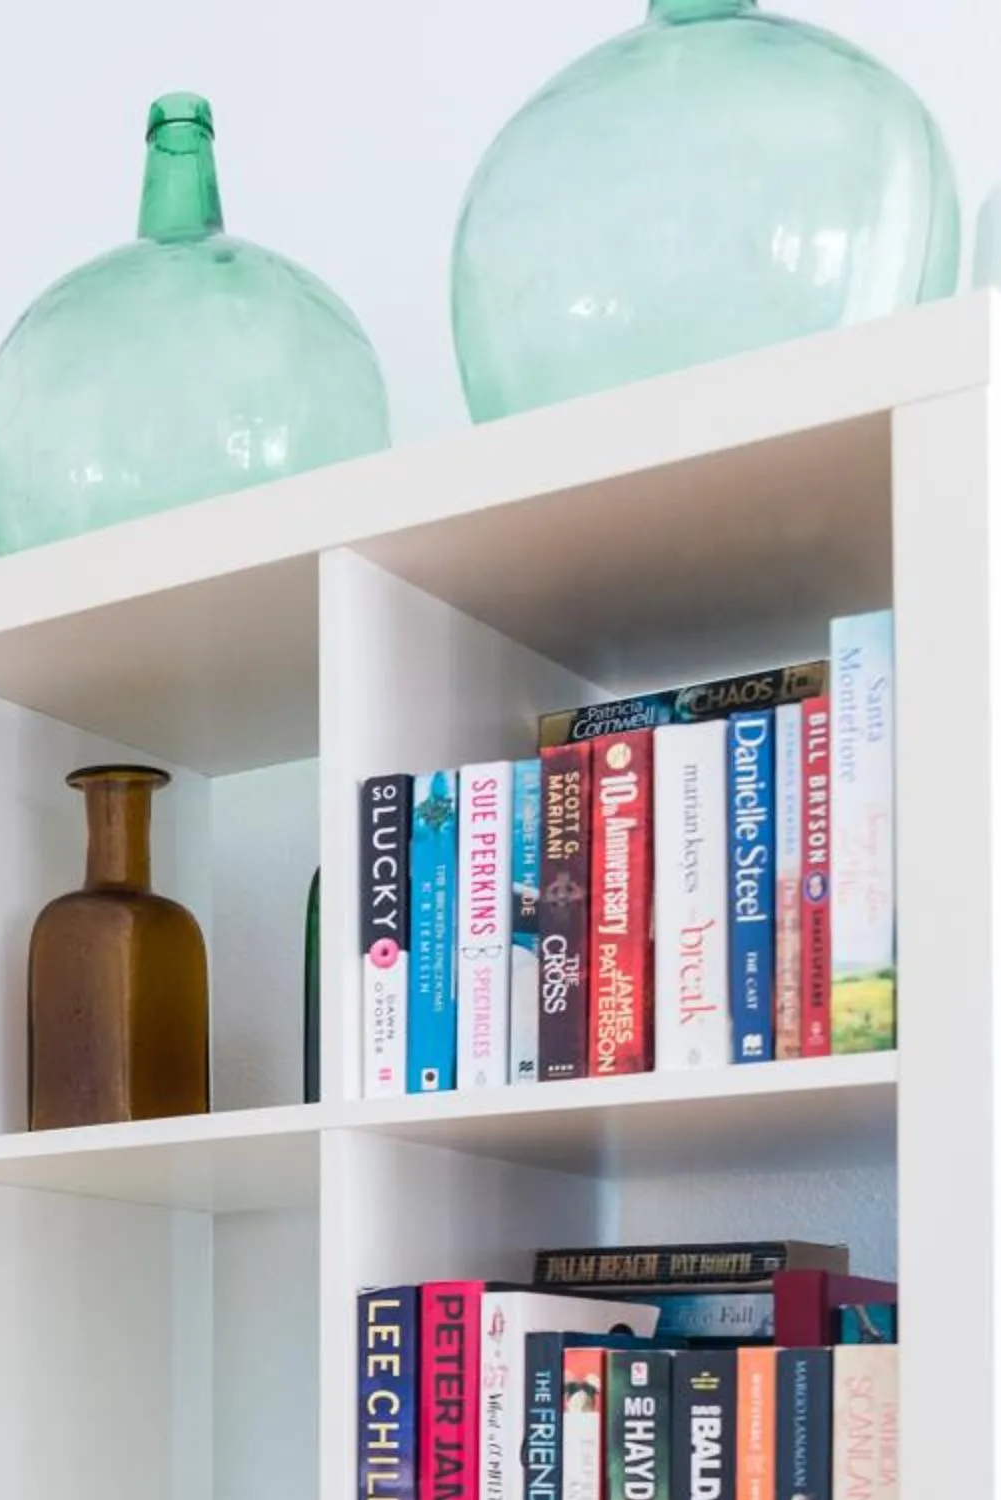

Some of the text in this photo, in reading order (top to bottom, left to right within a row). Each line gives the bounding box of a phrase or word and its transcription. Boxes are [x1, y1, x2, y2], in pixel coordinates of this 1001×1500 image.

[573, 701, 656, 739] Patricia Cornwell
[690, 678, 774, 713] CHAOS
[838, 647, 863, 784] Montefiore
[866, 676, 888, 744] Santa
[371, 785, 397, 802] SO
[547, 775, 563, 860] MARIANI
[564, 771, 581, 860] SCOTT G.
[681, 763, 707, 894] marian keyes
[733, 717, 768, 924] Danielle Steel
[809, 712, 828, 863] BILL BRYSON
[371, 805, 397, 930] LUCKY
[470, 778, 499, 940] SUE PERKINS
[519, 872, 535, 917] HDE
[599, 817, 637, 935] Anniversary
[542, 933, 569, 1014] CROSS
[568, 954, 581, 986] THE
[598, 943, 620, 1073] PATTERSON
[617, 973, 635, 1043] JAMES
[679, 918, 718, 1026] break
[745, 952, 758, 1011] THE CAST
[471, 966, 492, 1059] SPECTACLES
[366, 1299, 401, 1378] LEE
[721, 1304, 755, 1325] Fall
[433, 1295, 465, 1426] PETER
[534, 1370, 551, 1403] THE
[624, 1397, 655, 1416] MO
